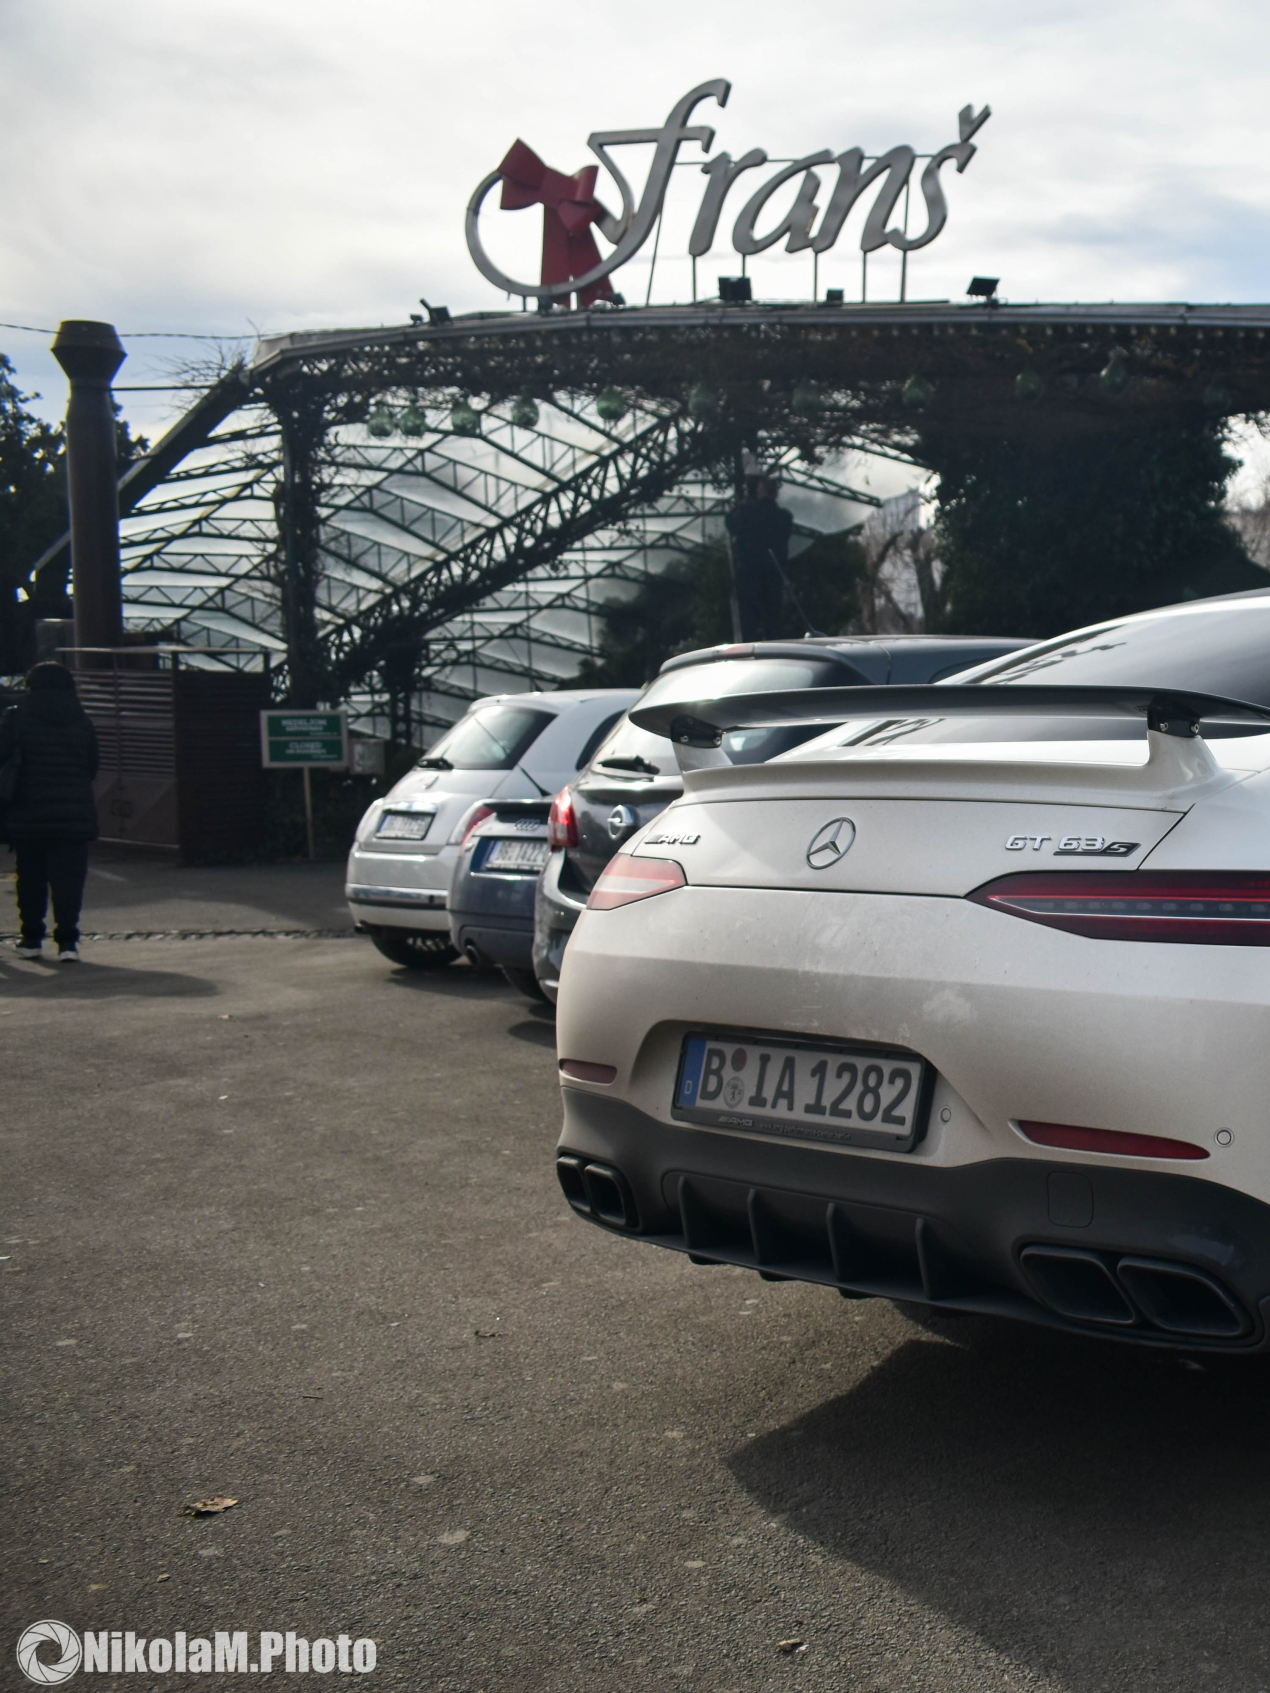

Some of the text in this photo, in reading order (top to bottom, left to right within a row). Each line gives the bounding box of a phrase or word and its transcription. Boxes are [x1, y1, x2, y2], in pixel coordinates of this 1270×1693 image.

[1005, 835, 1052, 851] GT
[699, 1047, 727, 1101] B
[748, 1052, 796, 1111] IA
[803, 1059, 913, 1126] 1282
